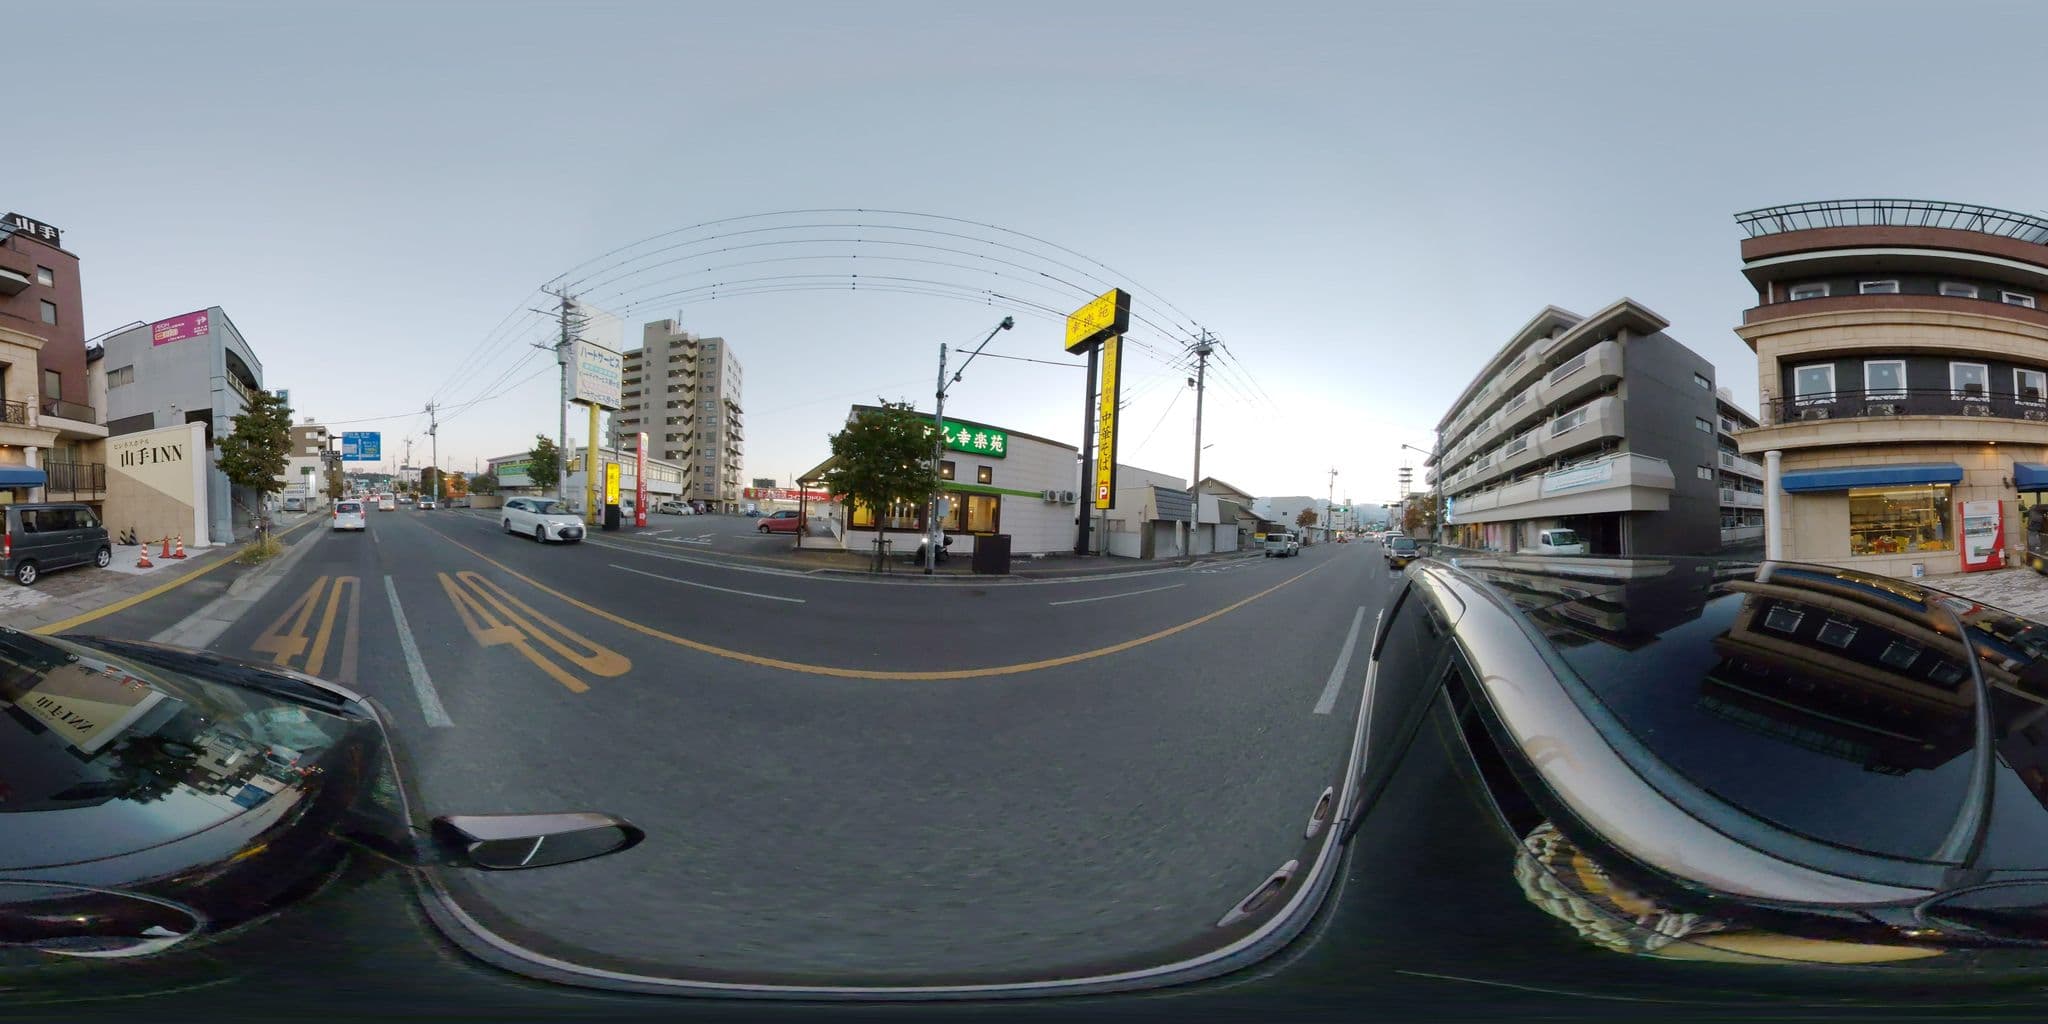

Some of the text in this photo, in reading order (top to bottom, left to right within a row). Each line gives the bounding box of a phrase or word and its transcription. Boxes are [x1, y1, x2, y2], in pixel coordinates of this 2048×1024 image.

[15, 216, 57, 240] 山手
[1099, 412, 1112, 471] 中華そば
[1099, 486, 1108, 500] P
[437, 571, 632, 694] 40
